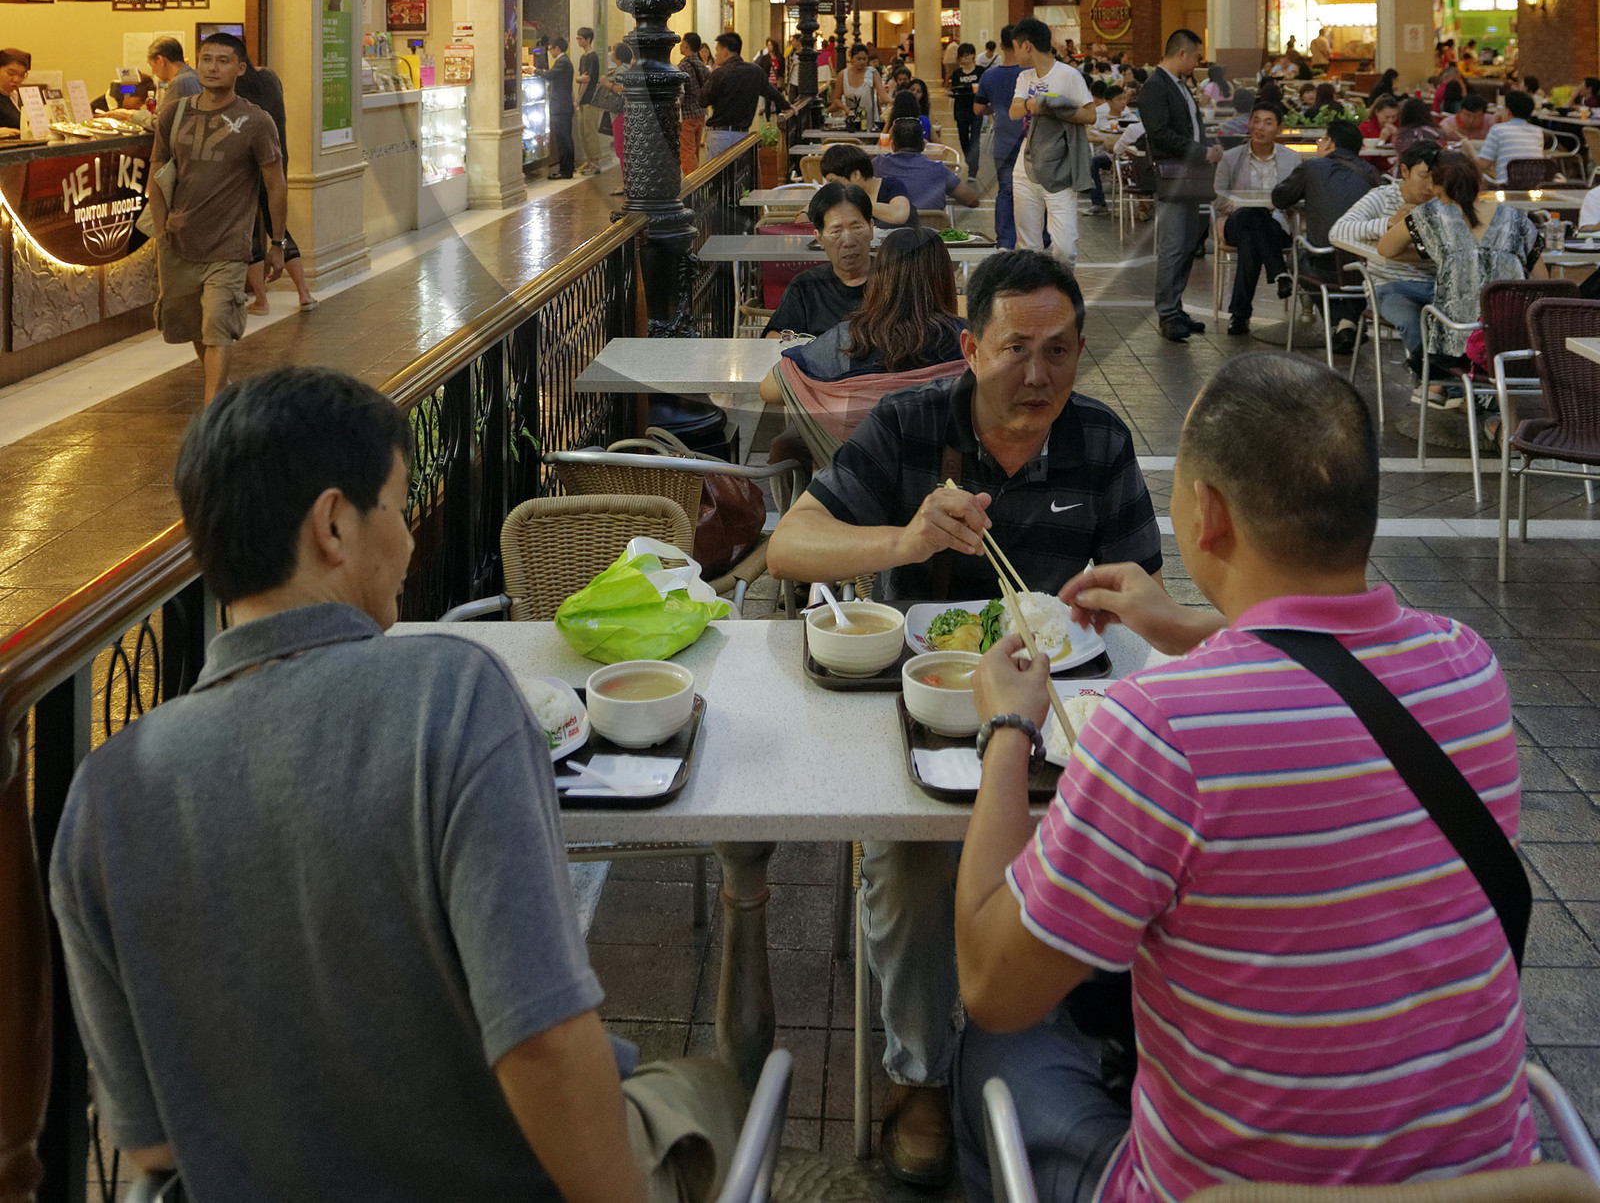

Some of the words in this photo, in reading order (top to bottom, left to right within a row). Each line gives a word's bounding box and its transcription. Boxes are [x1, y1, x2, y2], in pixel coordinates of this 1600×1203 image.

[177, 114, 231, 161] 42
[117, 154, 149, 198] KE
[74, 203, 108, 224] WONTON
[111, 196, 142, 216] NOODLE
